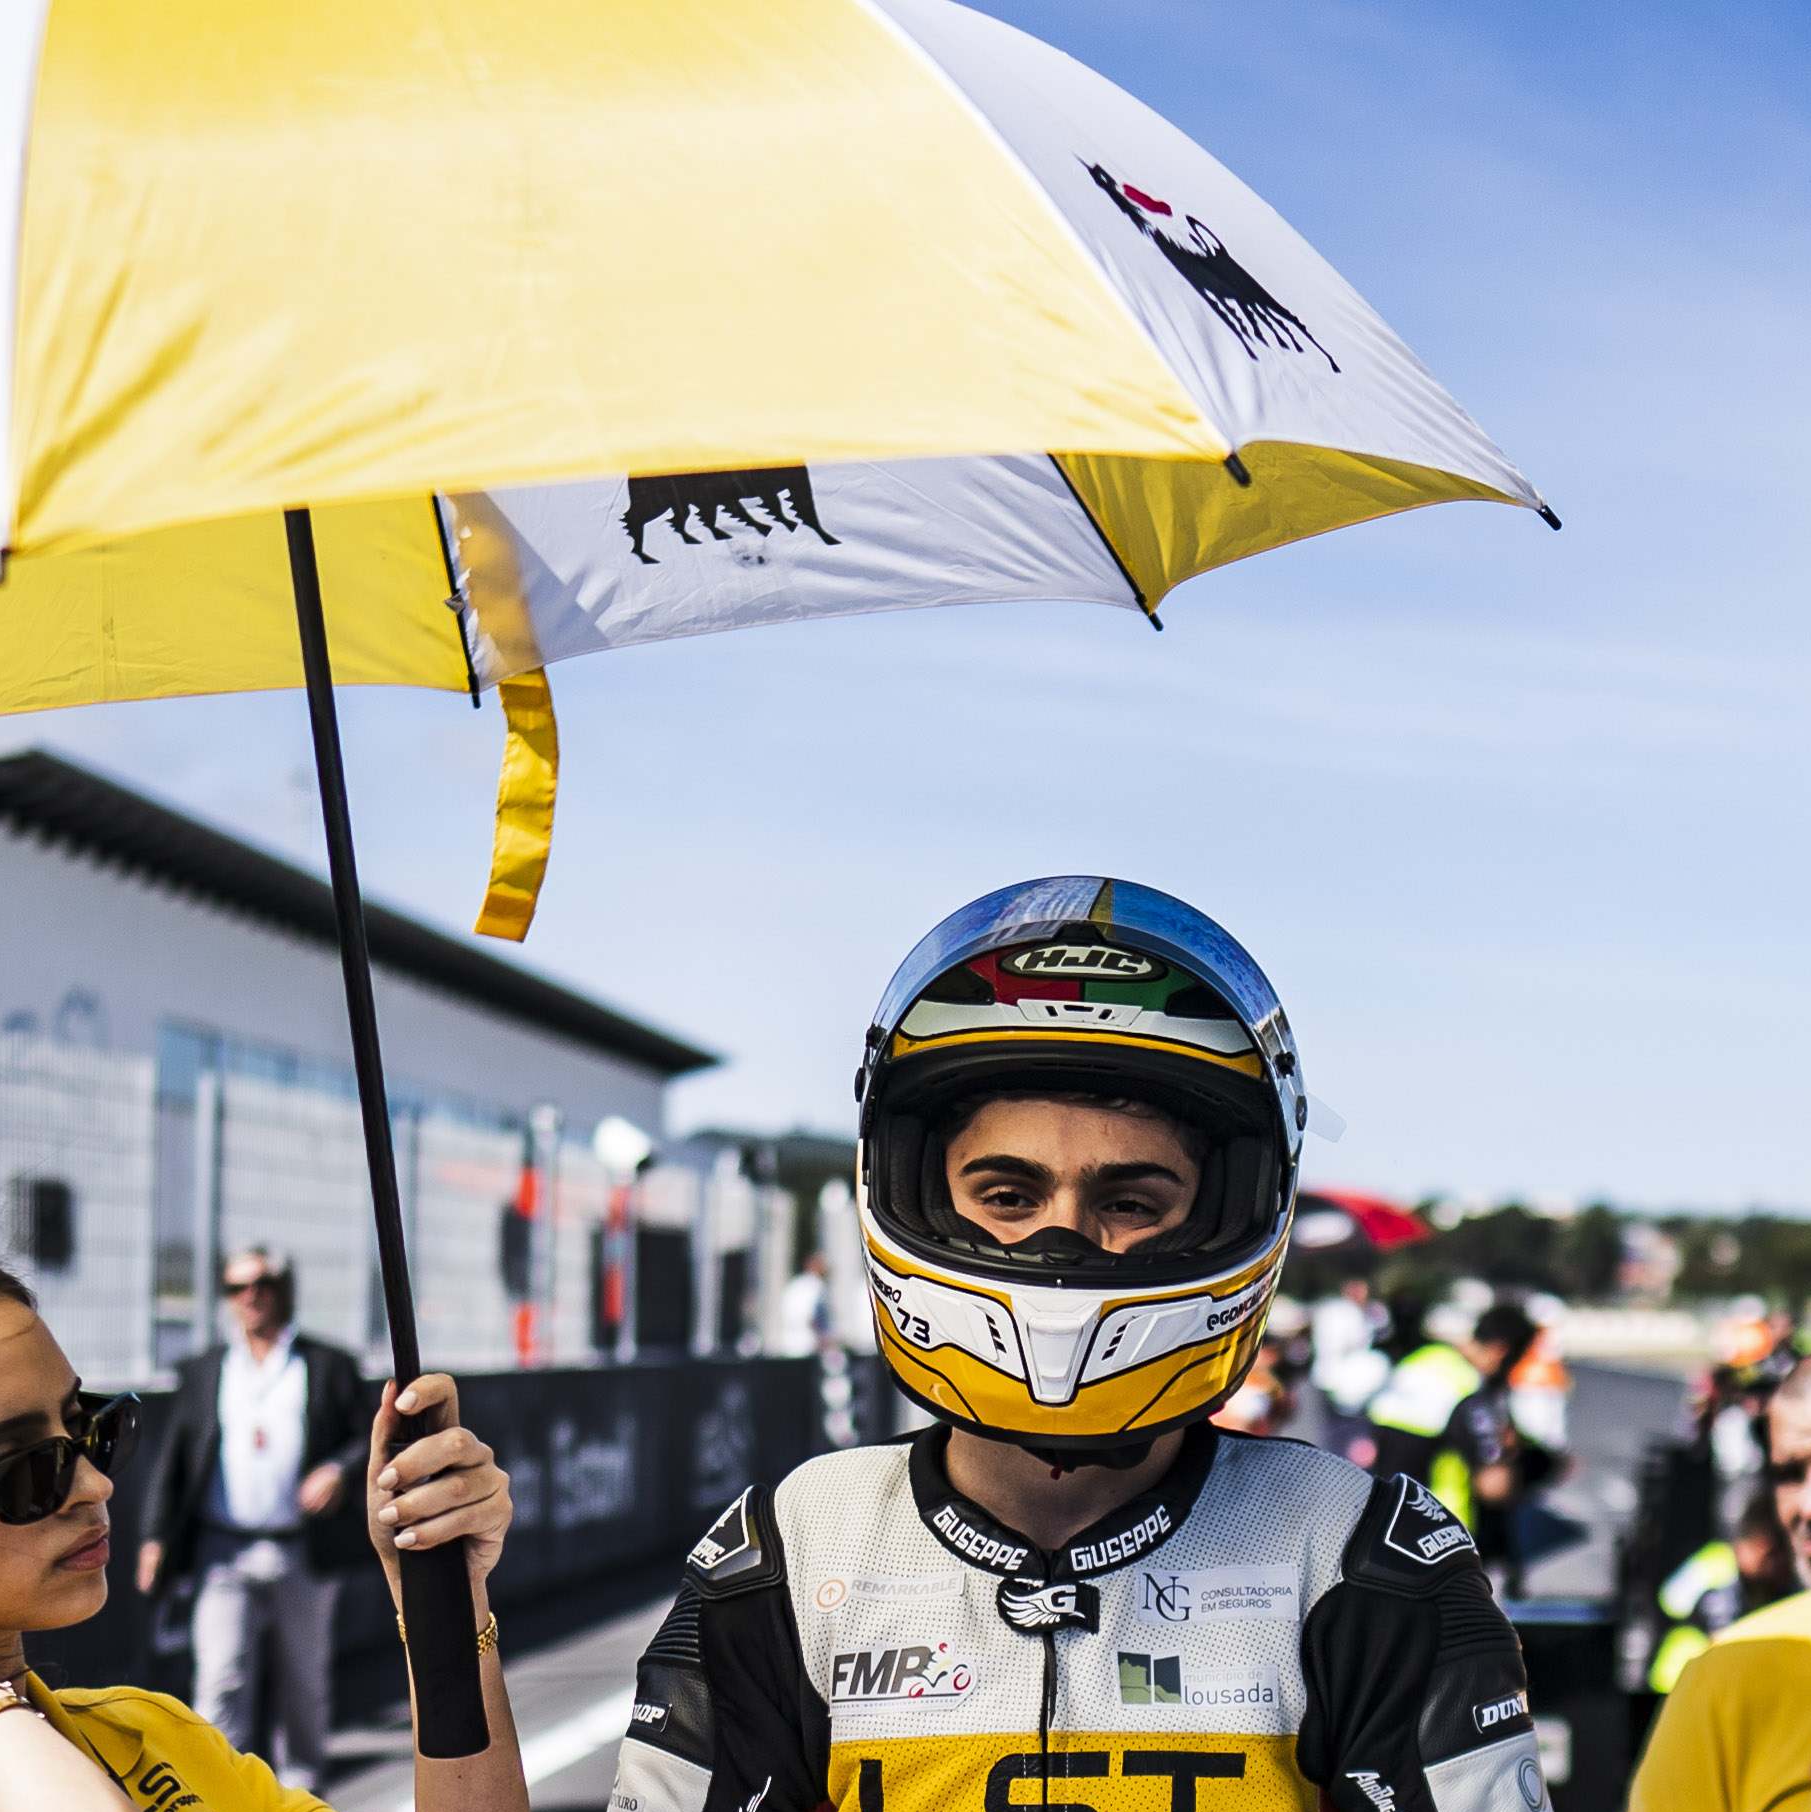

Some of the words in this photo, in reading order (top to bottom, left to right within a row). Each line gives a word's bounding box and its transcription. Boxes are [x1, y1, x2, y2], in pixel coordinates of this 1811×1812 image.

[1021, 949, 1146, 974] HJC
[897, 1306, 930, 1344] 73
[849, 1577, 958, 1596] REMARKABLE
[1201, 1584, 1293, 1601] CONSULTADORIA
[1201, 1602, 1216, 1612] EM
[1218, 1598, 1272, 1610] SEGUROS
[832, 1645, 932, 1698] FMP
[1246, 1668, 1264, 1680] de
[1184, 1683, 1275, 1706] lousada
[1481, 1693, 1529, 1727] DUN
